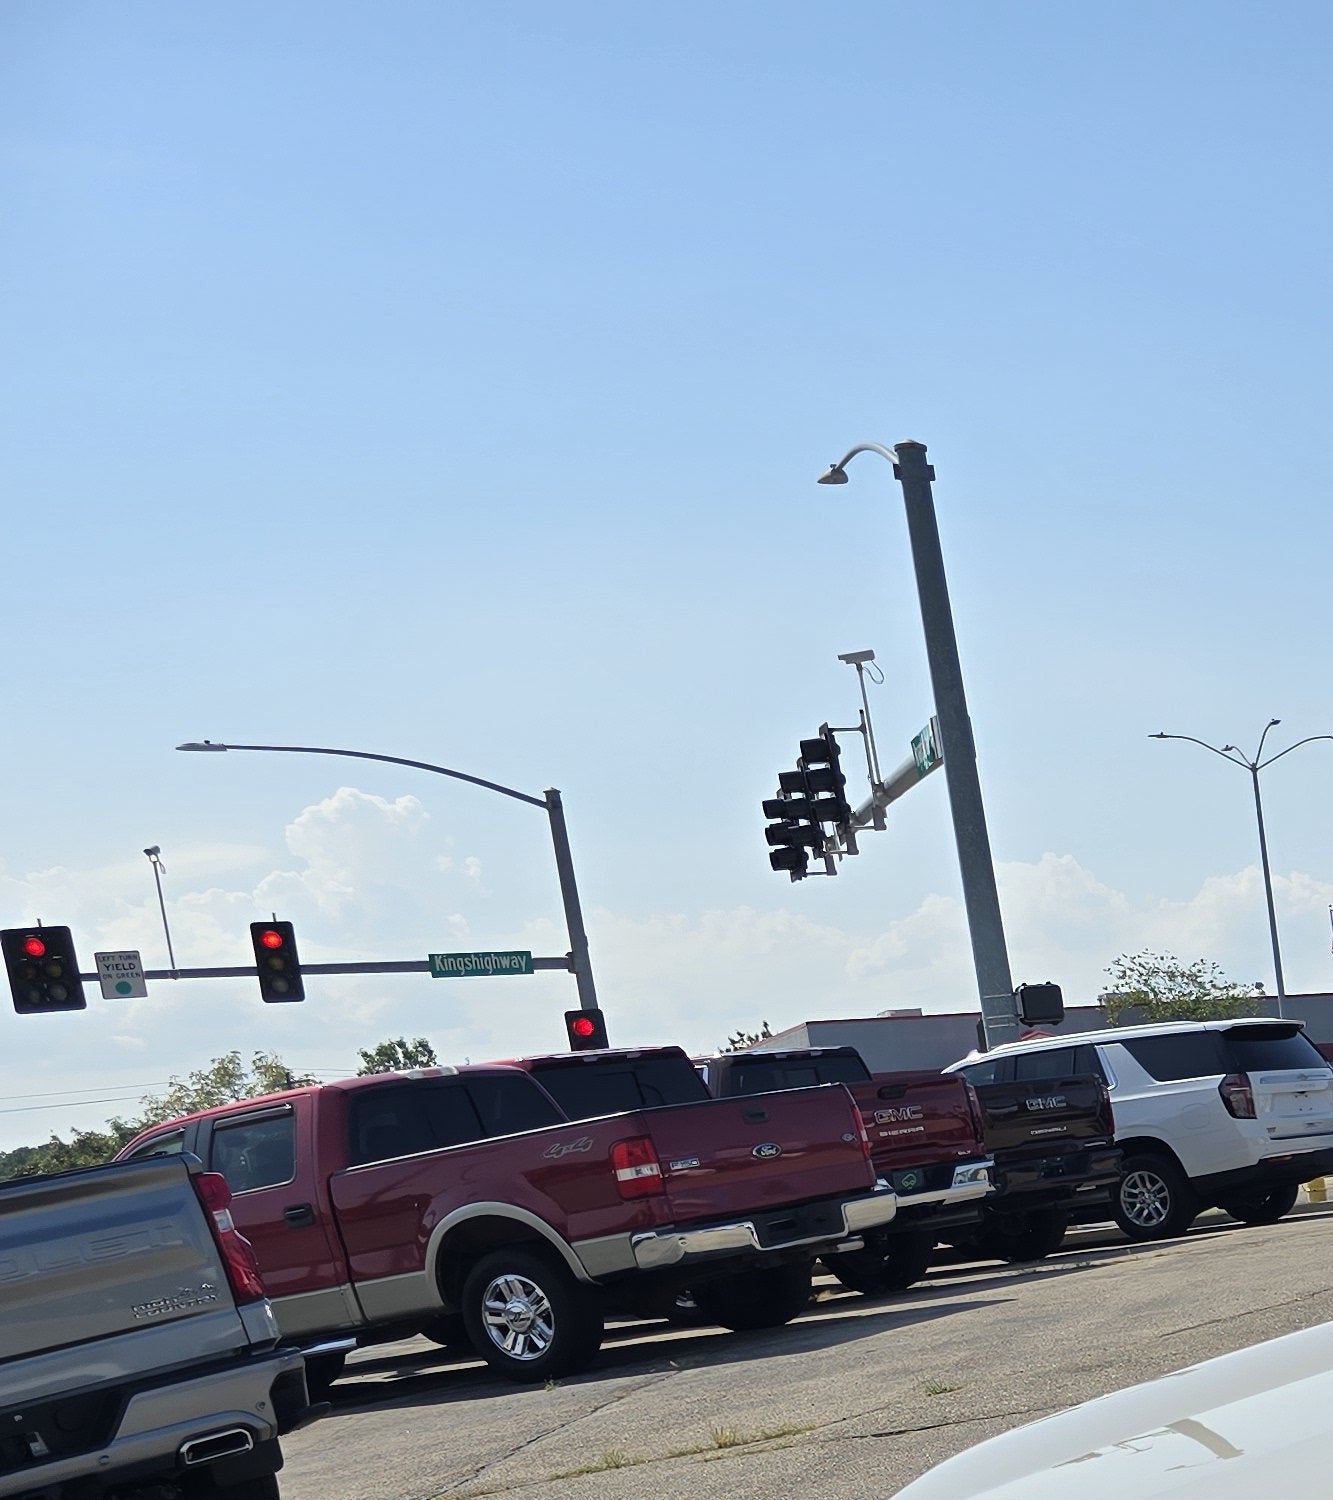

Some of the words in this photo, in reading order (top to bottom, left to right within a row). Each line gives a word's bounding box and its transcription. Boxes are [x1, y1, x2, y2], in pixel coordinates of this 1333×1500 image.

[103, 962, 136, 971] YIELD
[435, 953, 527, 976] Kingshighway
[1025, 1095, 1067, 1110] GMC
[875, 1105, 923, 1124] GMC
